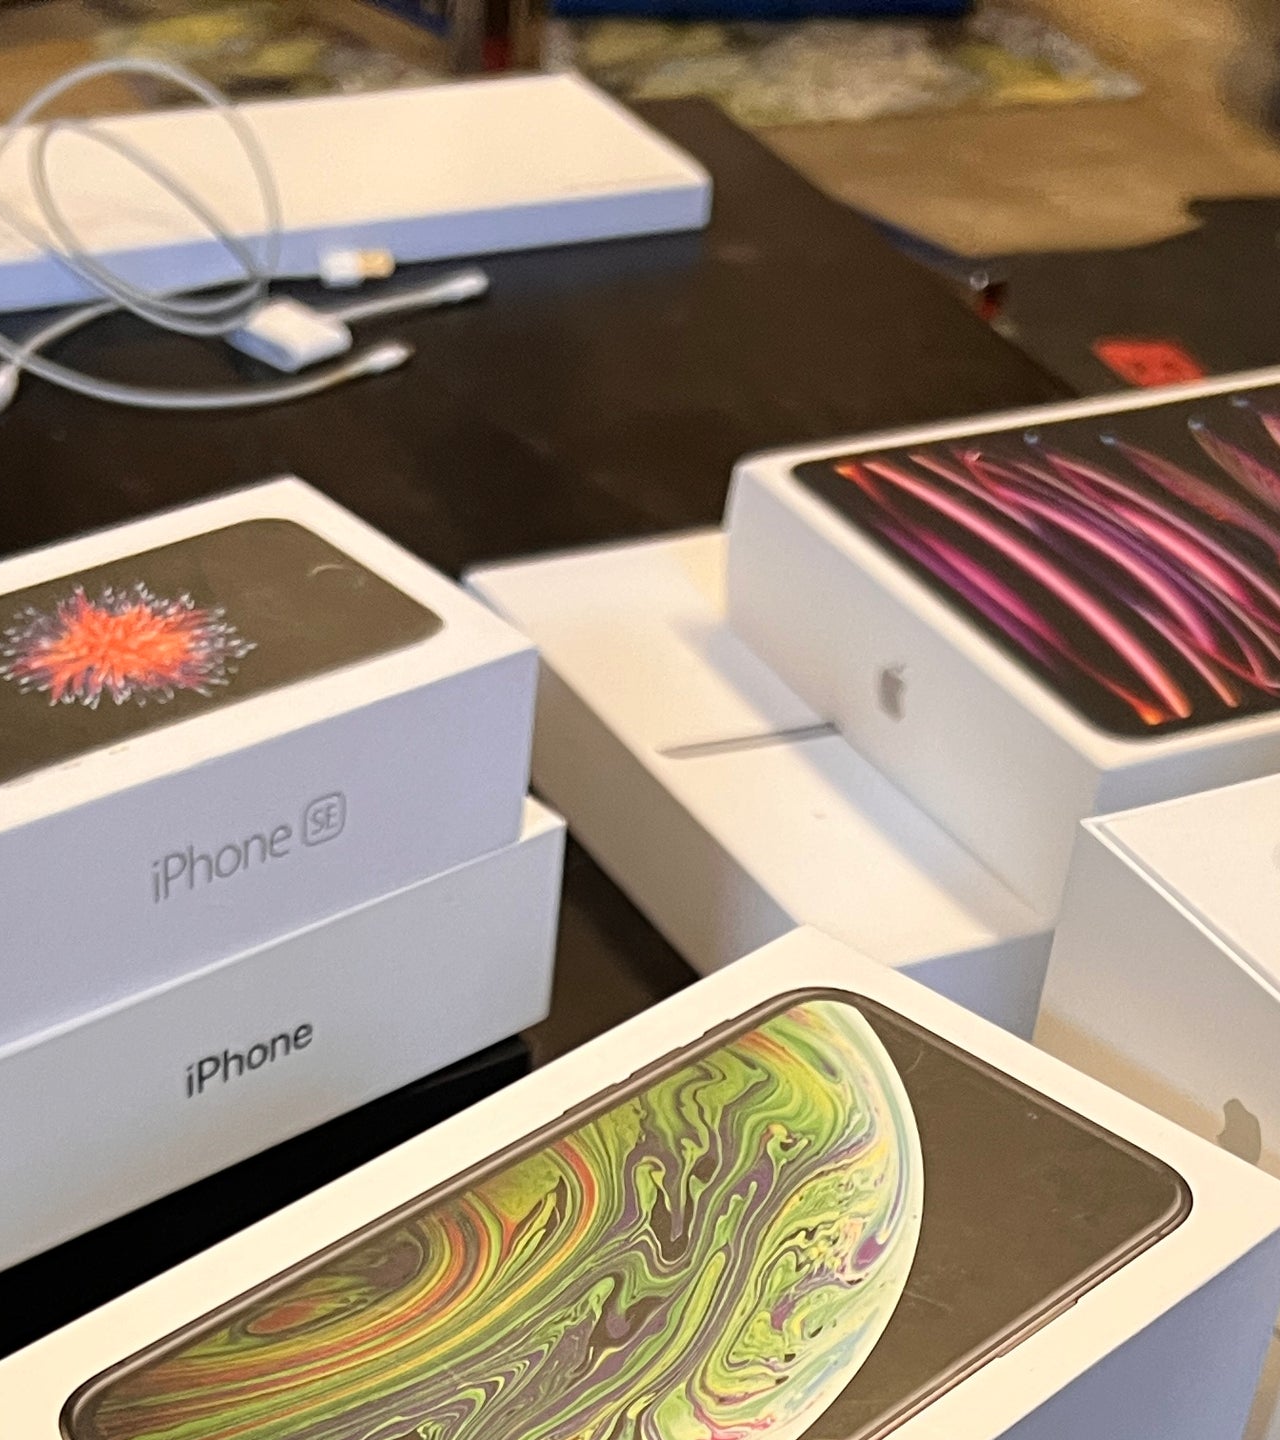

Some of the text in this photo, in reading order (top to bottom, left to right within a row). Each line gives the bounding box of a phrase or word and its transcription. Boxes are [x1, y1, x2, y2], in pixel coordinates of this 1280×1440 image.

[151, 802, 339, 904] iPhone SE
[183, 1022, 315, 1100] iPhone
